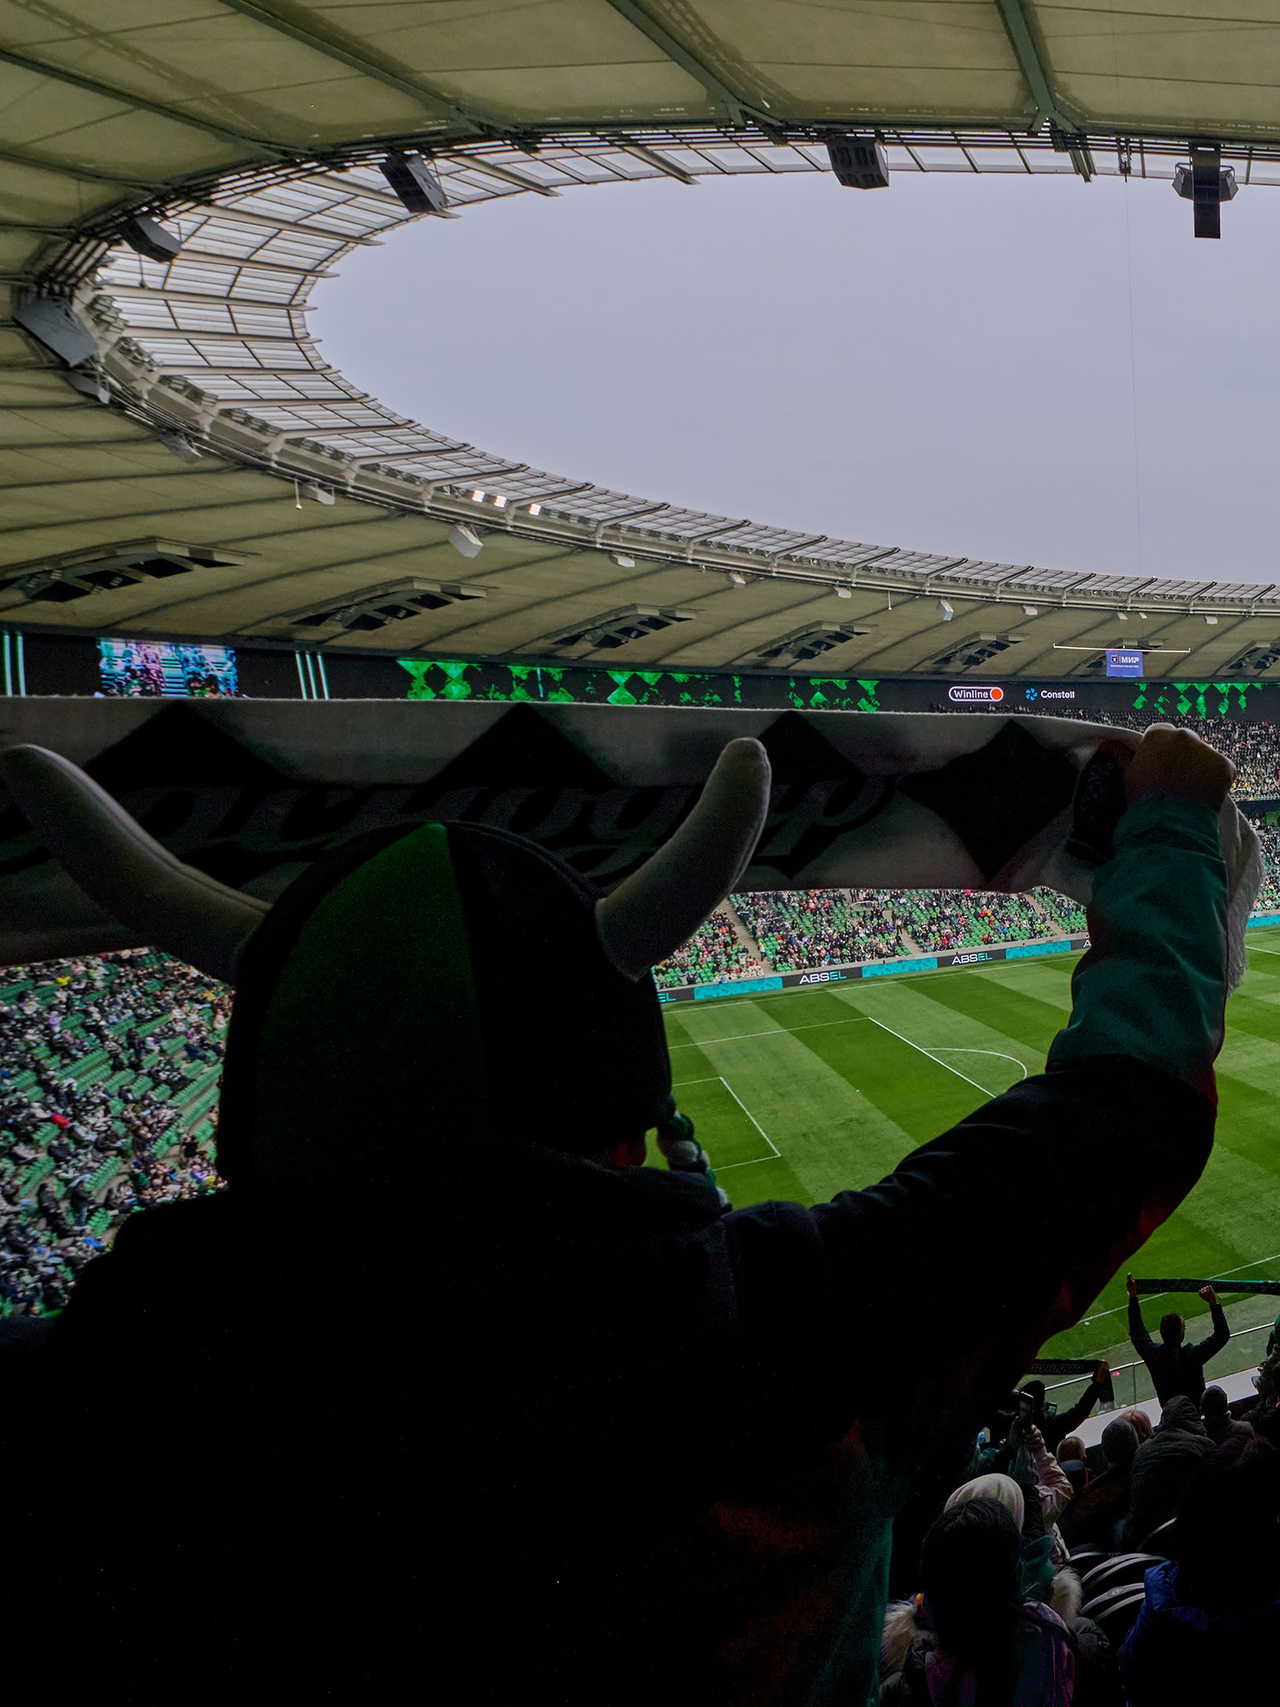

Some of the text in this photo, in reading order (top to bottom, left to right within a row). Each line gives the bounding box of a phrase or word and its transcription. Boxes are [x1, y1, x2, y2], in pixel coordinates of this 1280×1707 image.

[1121, 656, 1140, 664] МИР
[953, 689, 988, 699] Winline
[1040, 690, 1075, 699] Constell
[951, 952, 993, 965] ABSEL
[799, 968, 847, 984] ABSEL
